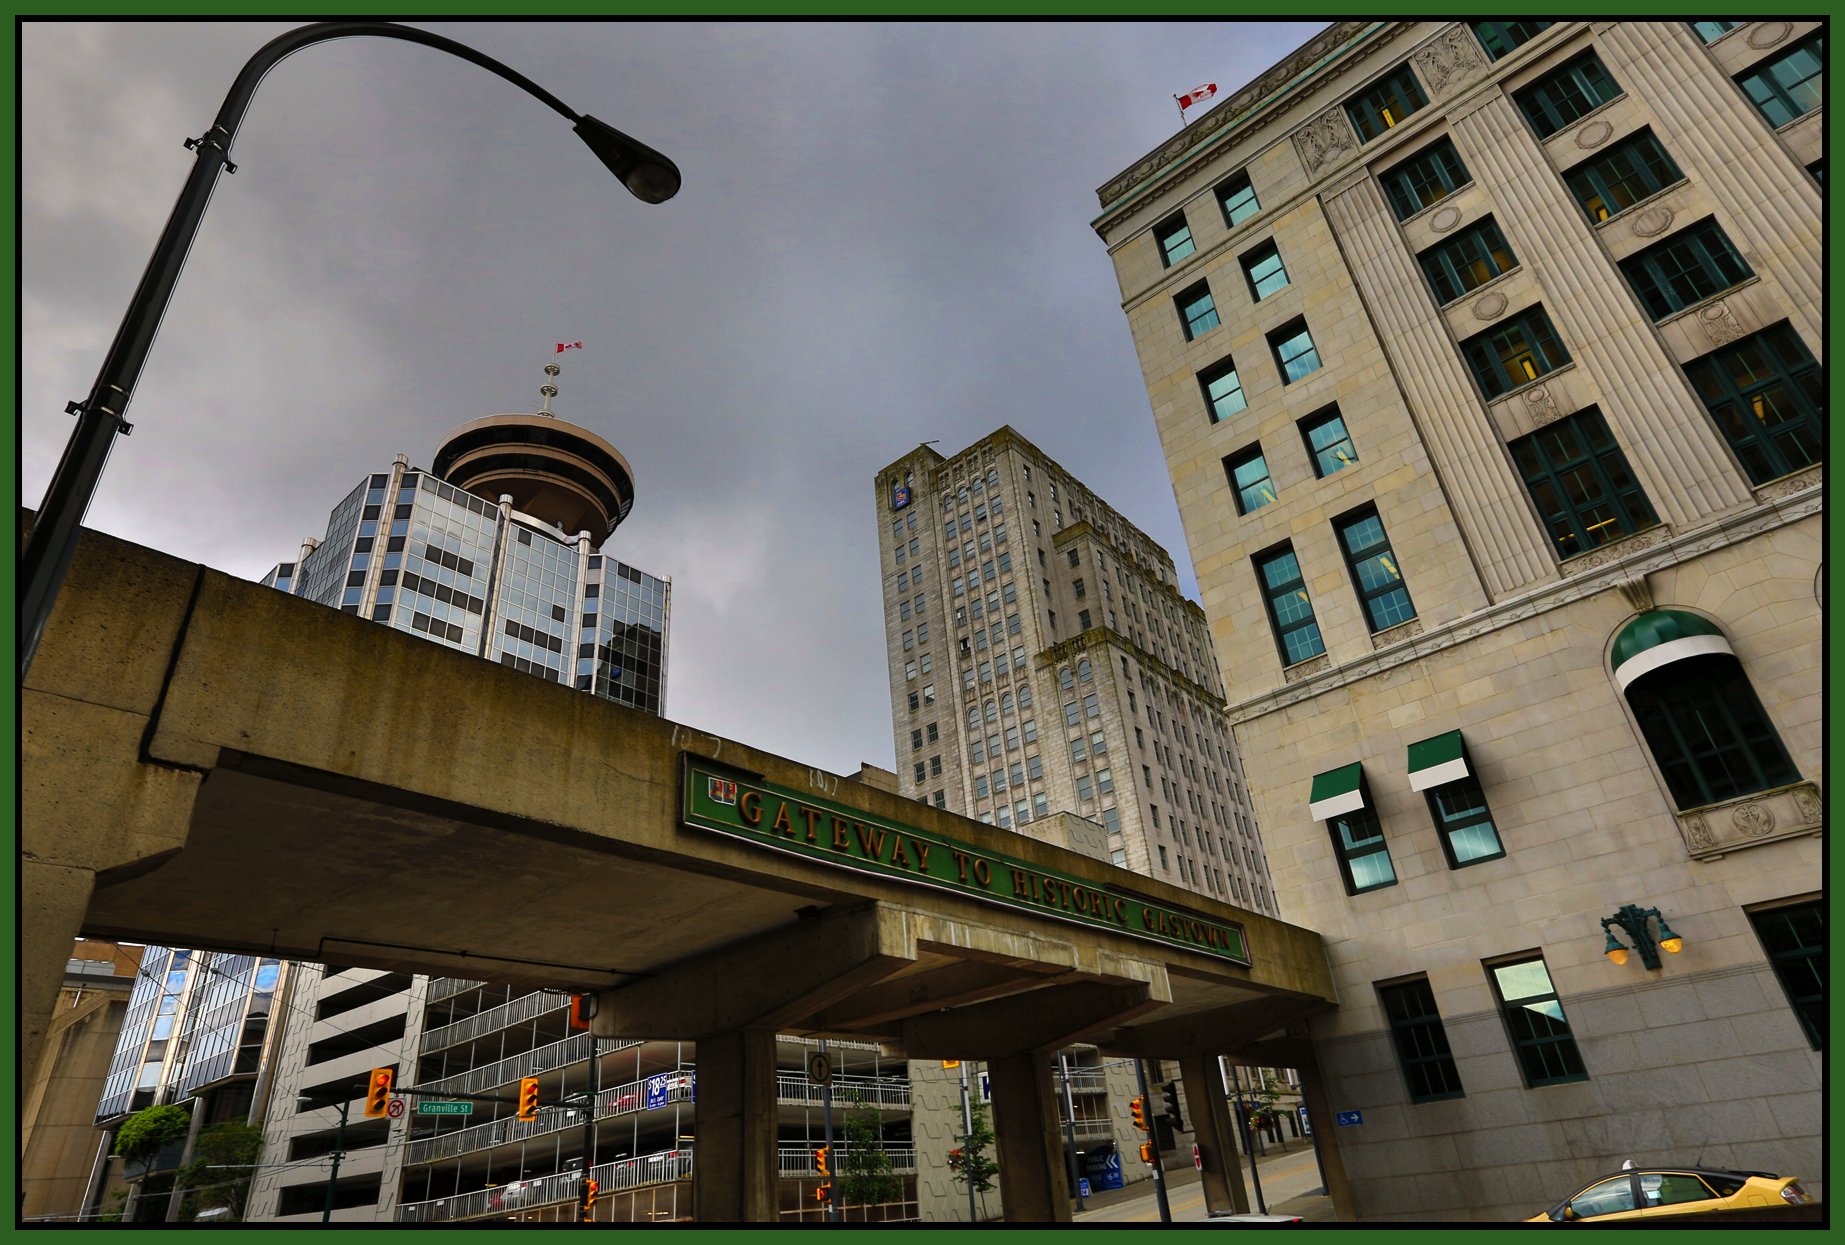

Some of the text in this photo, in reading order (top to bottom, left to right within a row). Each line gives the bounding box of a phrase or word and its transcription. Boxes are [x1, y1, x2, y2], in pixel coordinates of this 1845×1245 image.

[740, 791, 1231, 949] GATEWAY TO HISTORIC GASTOWN
[423, 1104, 468, 1113] Granville St
